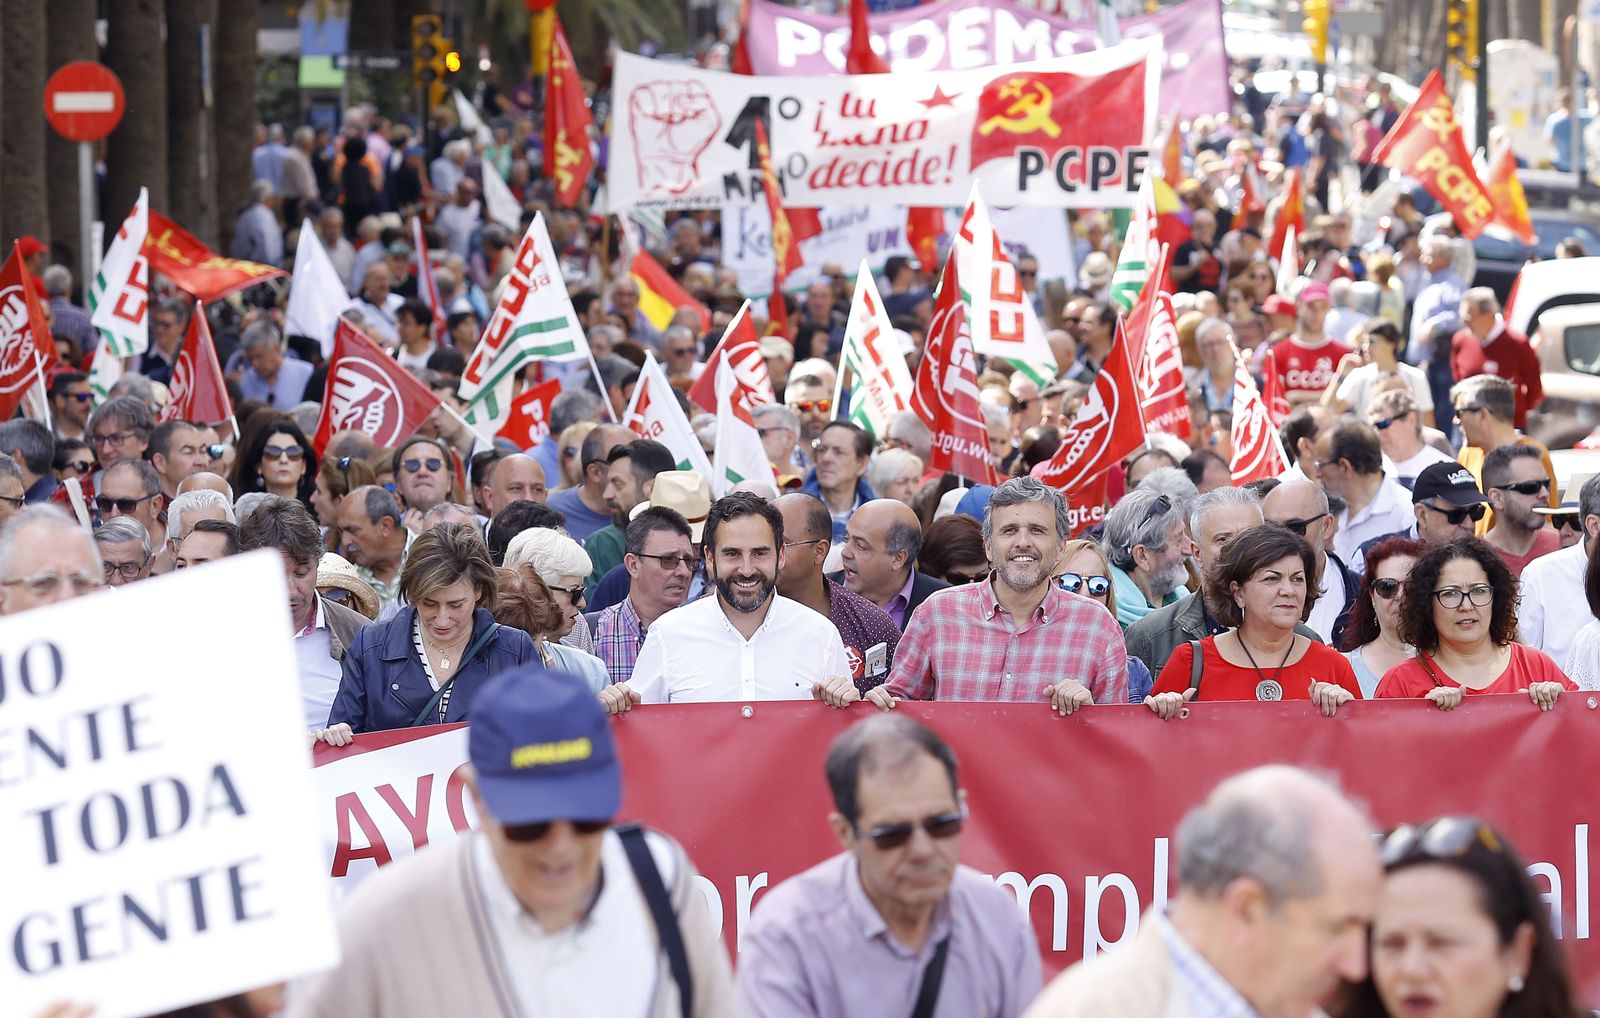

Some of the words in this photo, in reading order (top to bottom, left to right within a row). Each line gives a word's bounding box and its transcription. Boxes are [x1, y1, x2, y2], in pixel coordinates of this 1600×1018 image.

[775, 6, 1162, 76] PODEMO
[808, 144, 957, 190] decide!
[1018, 146, 1148, 193] PCPE
[1415, 146, 1494, 226] PCPE
[28, 764, 248, 866] TODA
[12, 857, 276, 976] GENTE
